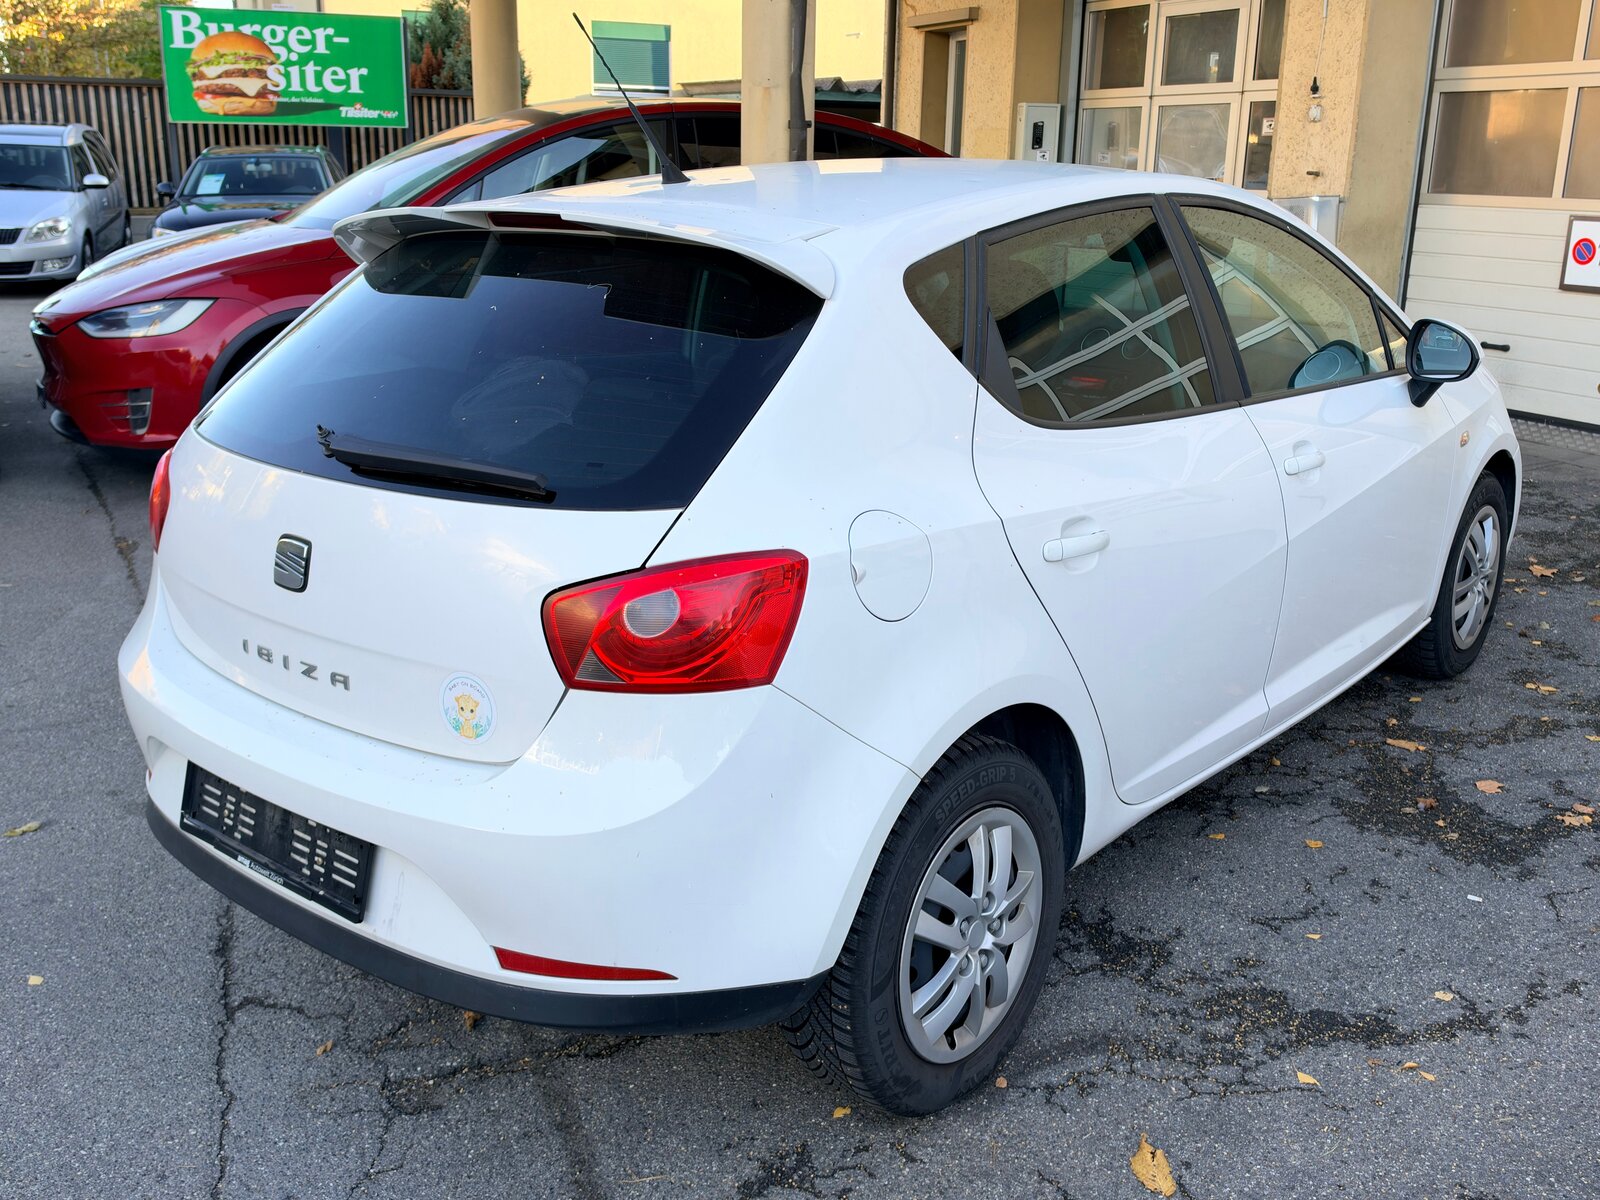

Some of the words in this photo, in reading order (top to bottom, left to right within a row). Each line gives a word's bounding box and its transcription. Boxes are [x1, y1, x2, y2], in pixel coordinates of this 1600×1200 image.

[267, 52, 368, 94] siter
[242, 638, 350, 691] IBIZA
[935, 766, 1007, 823] SPEED-GRIP
